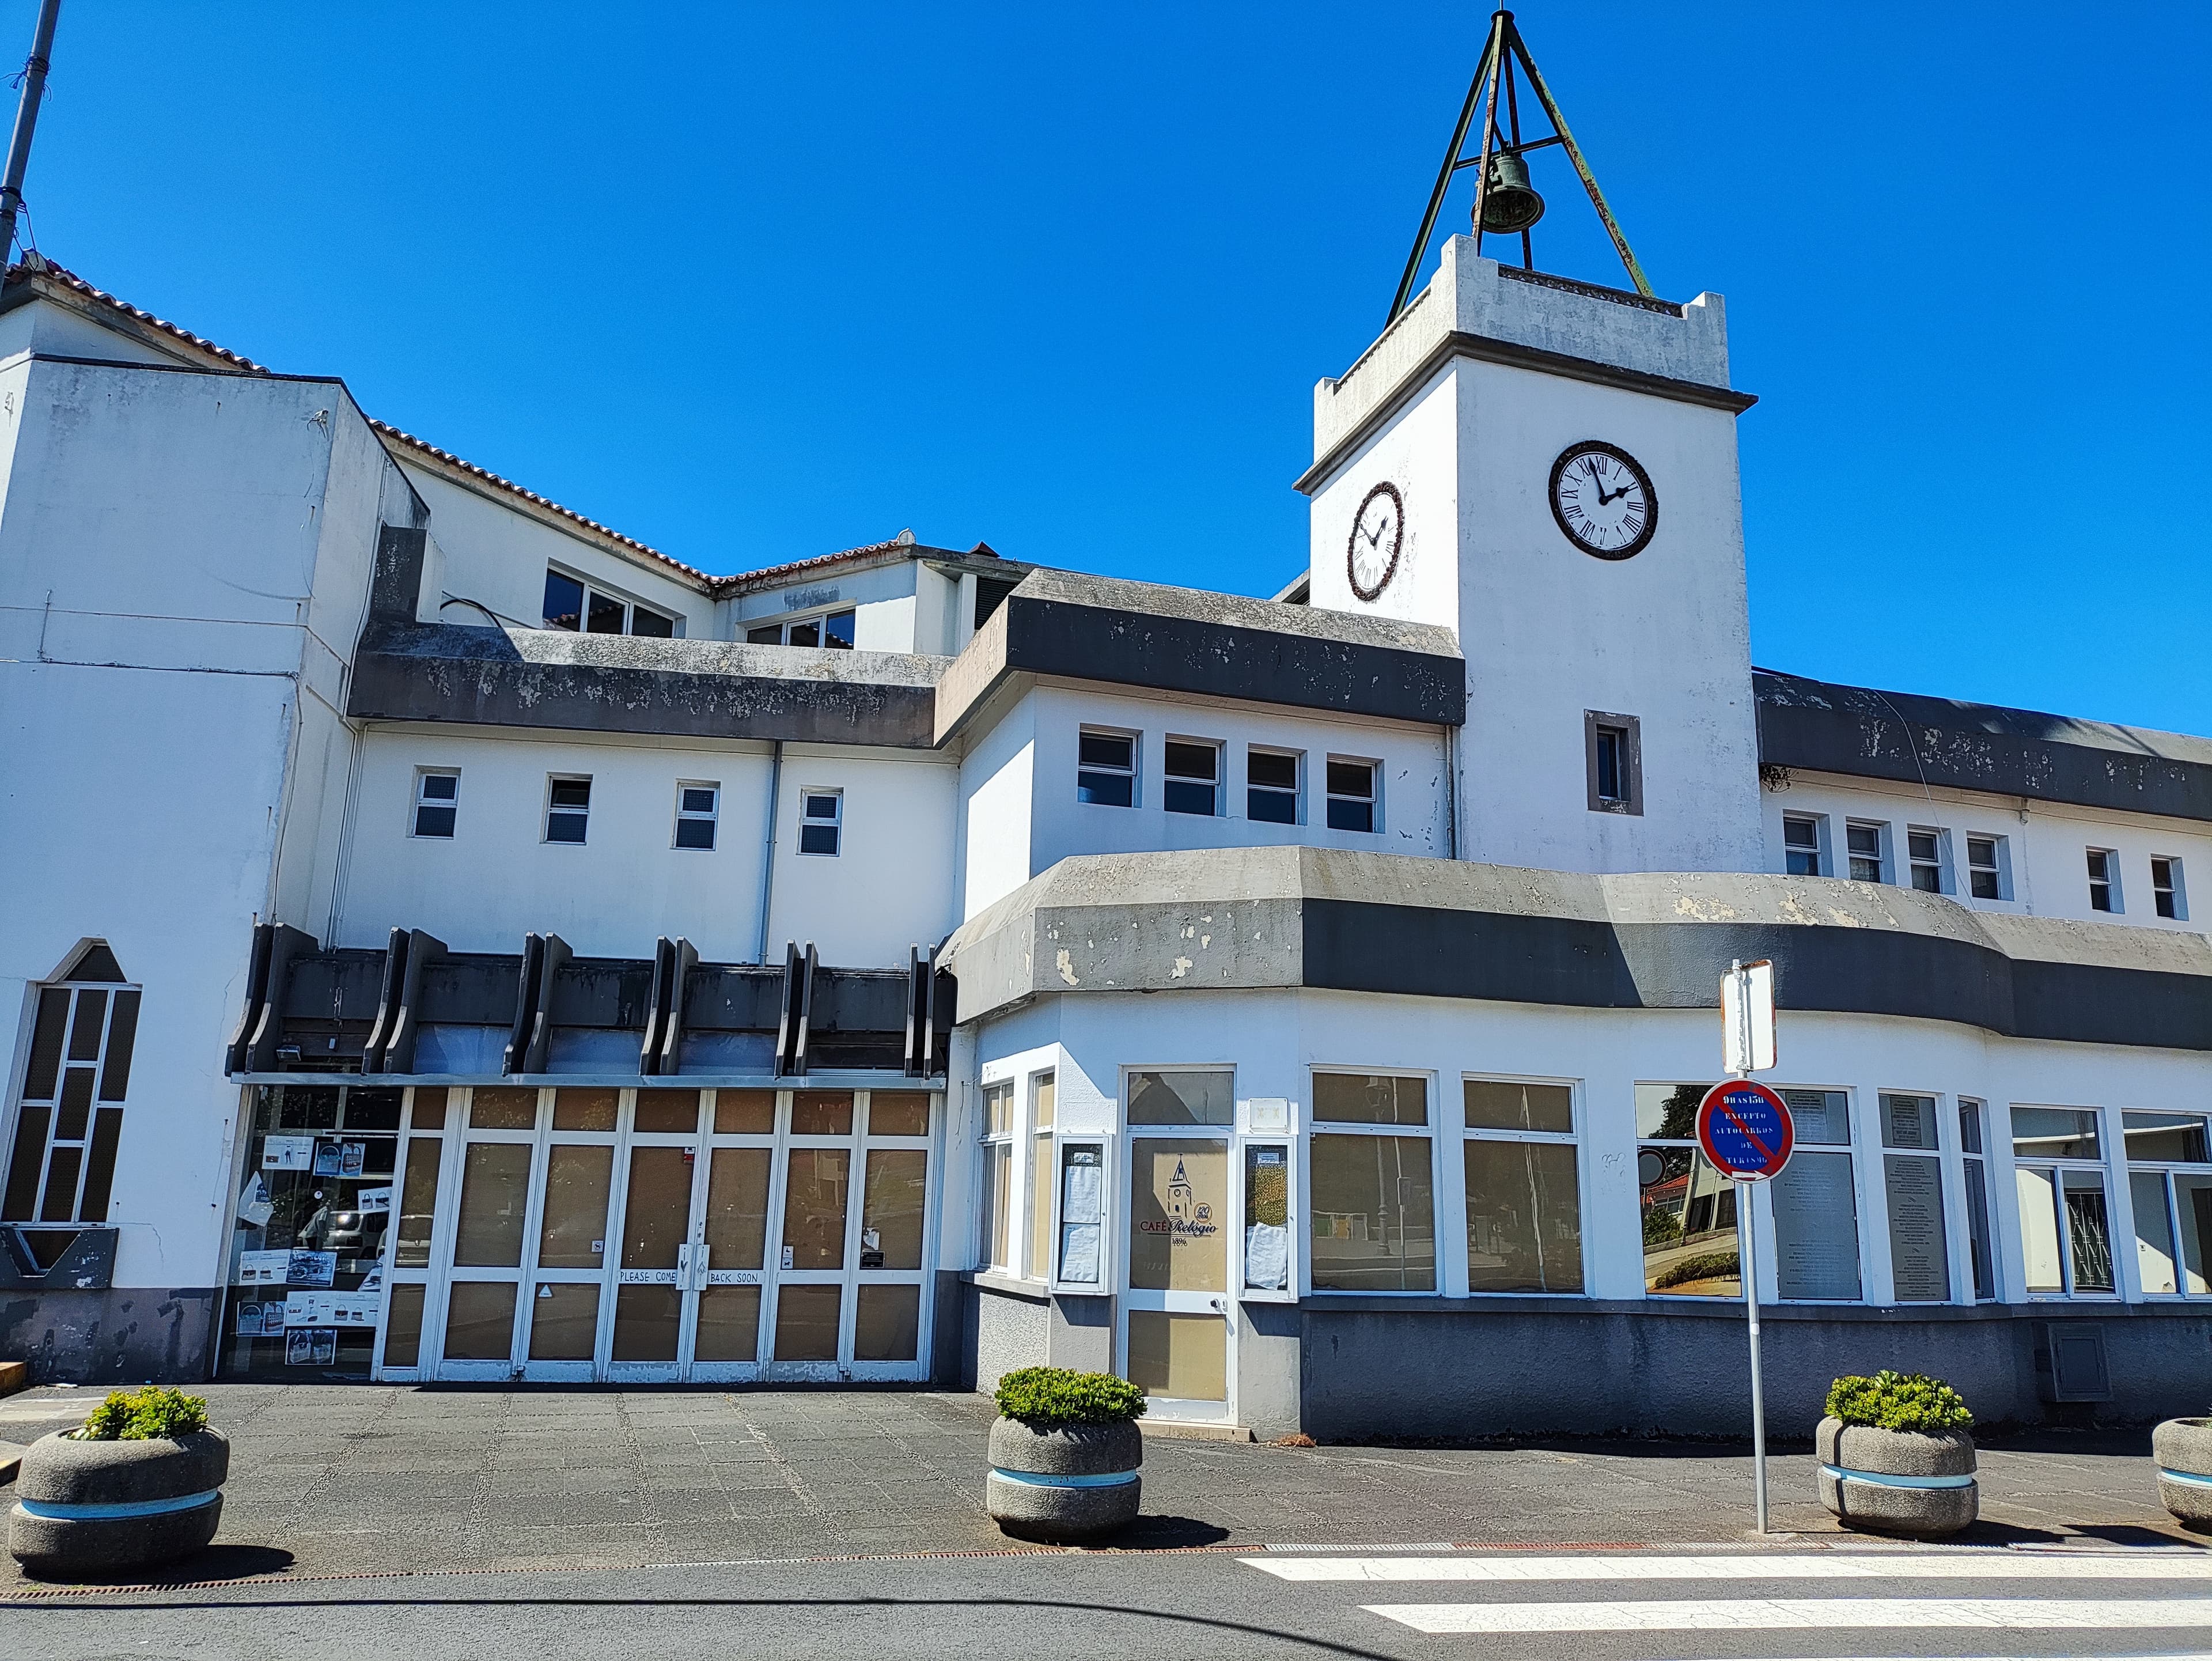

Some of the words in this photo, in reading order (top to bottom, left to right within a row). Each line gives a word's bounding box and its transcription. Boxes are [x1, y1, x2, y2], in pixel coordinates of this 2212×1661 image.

[1724, 1112, 1766, 1120] EXCEPTO
[1740, 1141, 1753, 1149] DE
[1197, 1206, 1210, 1214] 120
[1140, 1220, 1166, 1231] CAFÉ
[1168, 1219, 1217, 1238] Relógio
[1172, 1238, 1187, 1246] 1896
[620, 1271, 650, 1282] PLEASE
[656, 1271, 676, 1282] COME
[710, 1273, 732, 1283] BACK
[737, 1273, 759, 1283] SOON
